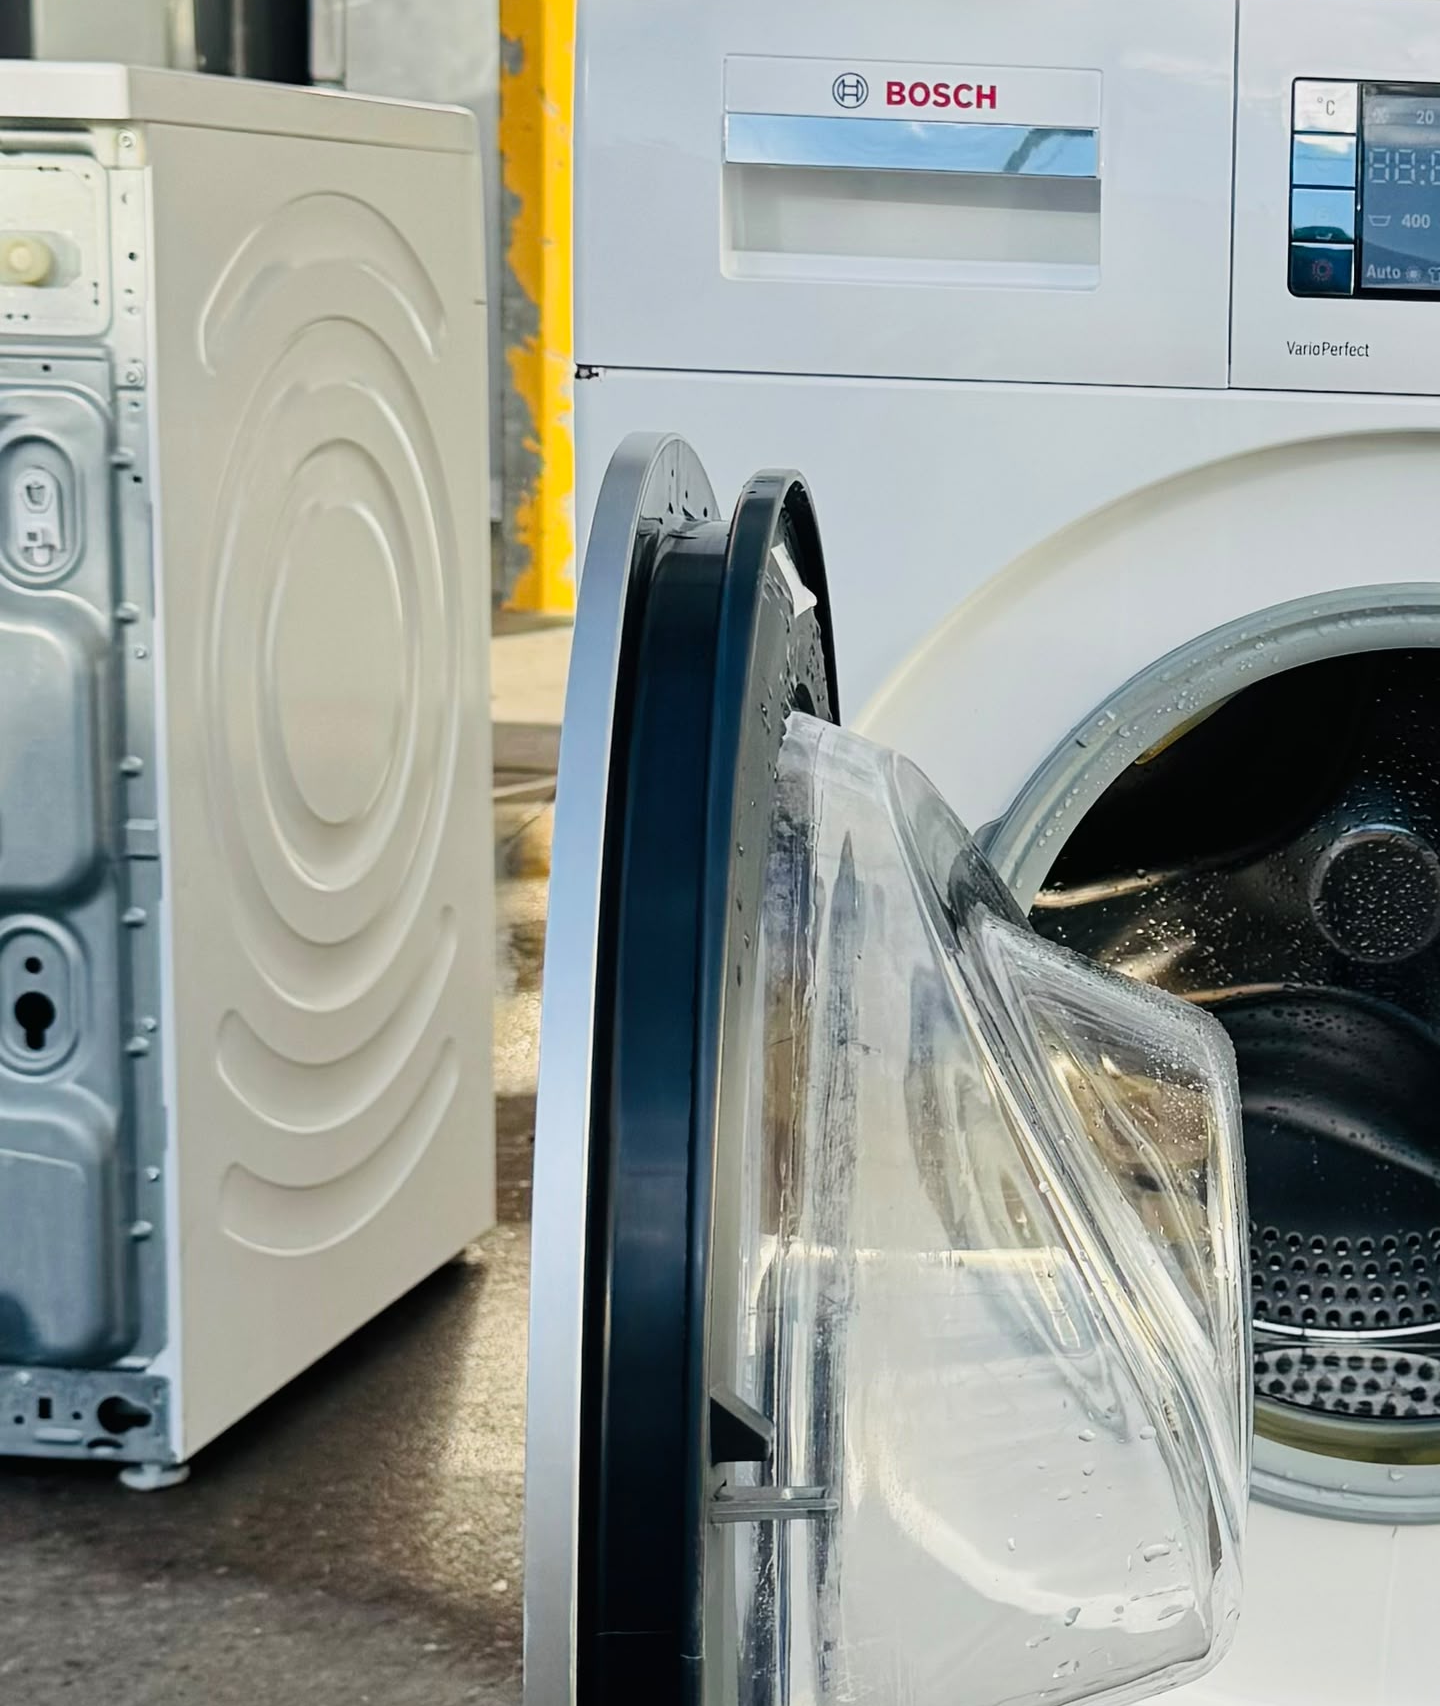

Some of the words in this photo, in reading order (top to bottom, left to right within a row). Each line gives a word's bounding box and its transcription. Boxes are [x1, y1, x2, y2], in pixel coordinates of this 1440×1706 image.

[886, 80, 997, 110] BOSCH
[1416, 110, 1435, 125] 20
[1401, 213, 1431, 229] 400
[1366, 264, 1401, 279] Auto
[1287, 340, 1370, 359] VarioPerfect
